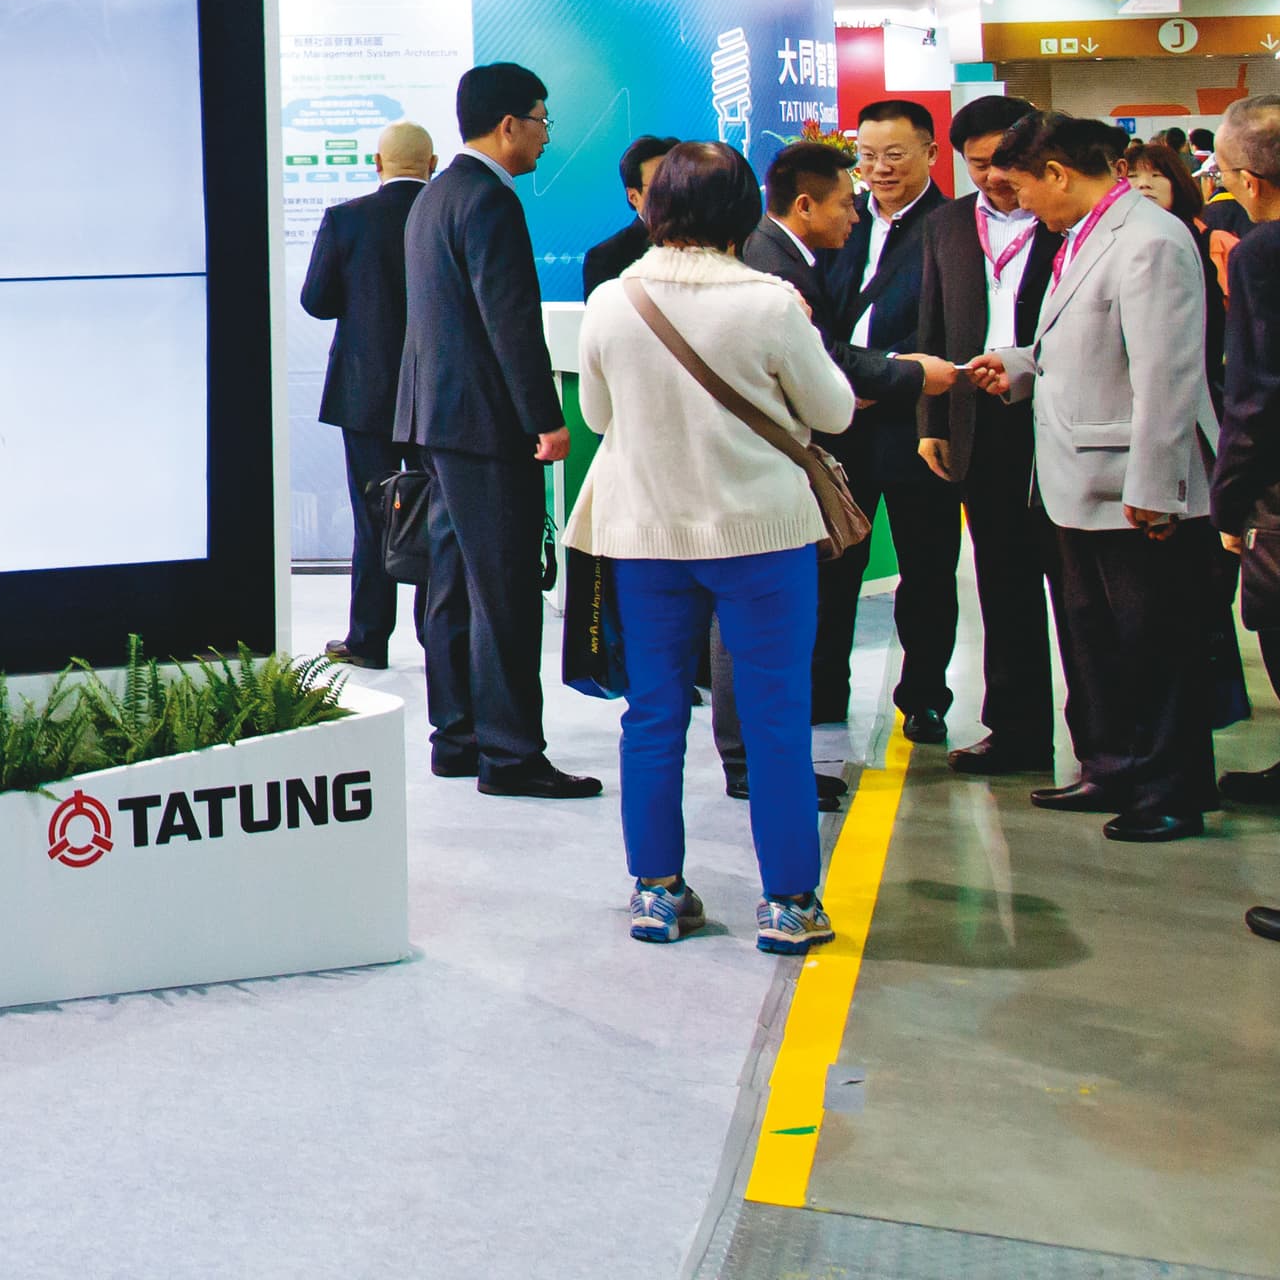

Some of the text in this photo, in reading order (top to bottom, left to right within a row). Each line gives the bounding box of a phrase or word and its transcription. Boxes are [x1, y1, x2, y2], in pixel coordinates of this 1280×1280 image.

[1170, 23, 1185, 49] J
[778, 100, 818, 123] TATUNG
[117, 769, 373, 848] TATUNG
